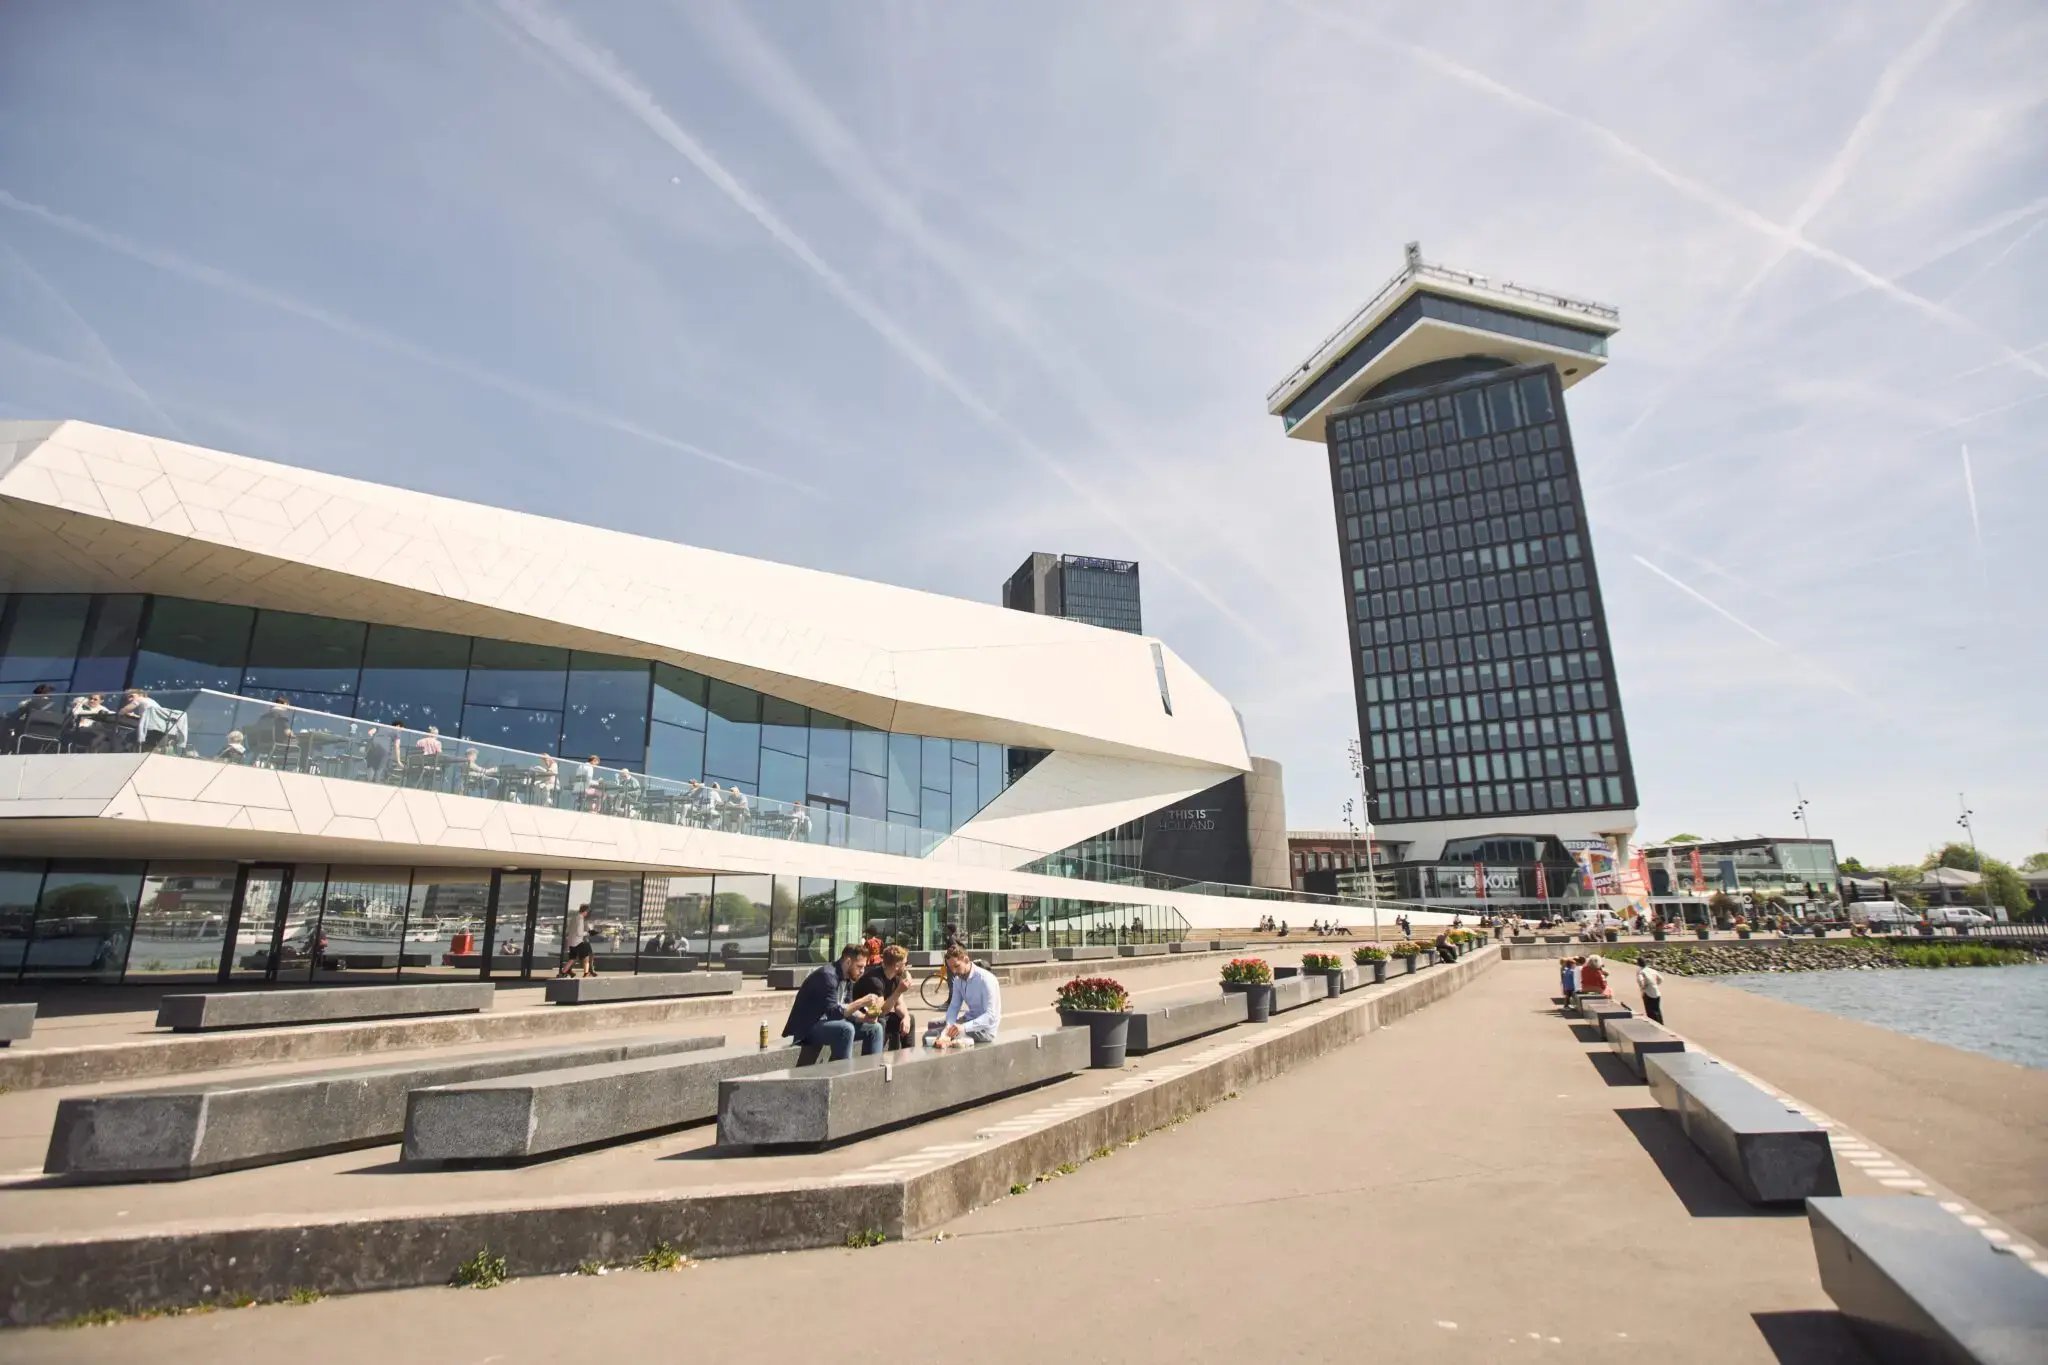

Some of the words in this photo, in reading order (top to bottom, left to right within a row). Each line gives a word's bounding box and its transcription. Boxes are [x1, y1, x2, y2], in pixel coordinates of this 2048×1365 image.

[1168, 809, 1195, 820] THIS
[1196, 809, 1207, 819] IS
[1457, 874, 1518, 889] LOKOUT
